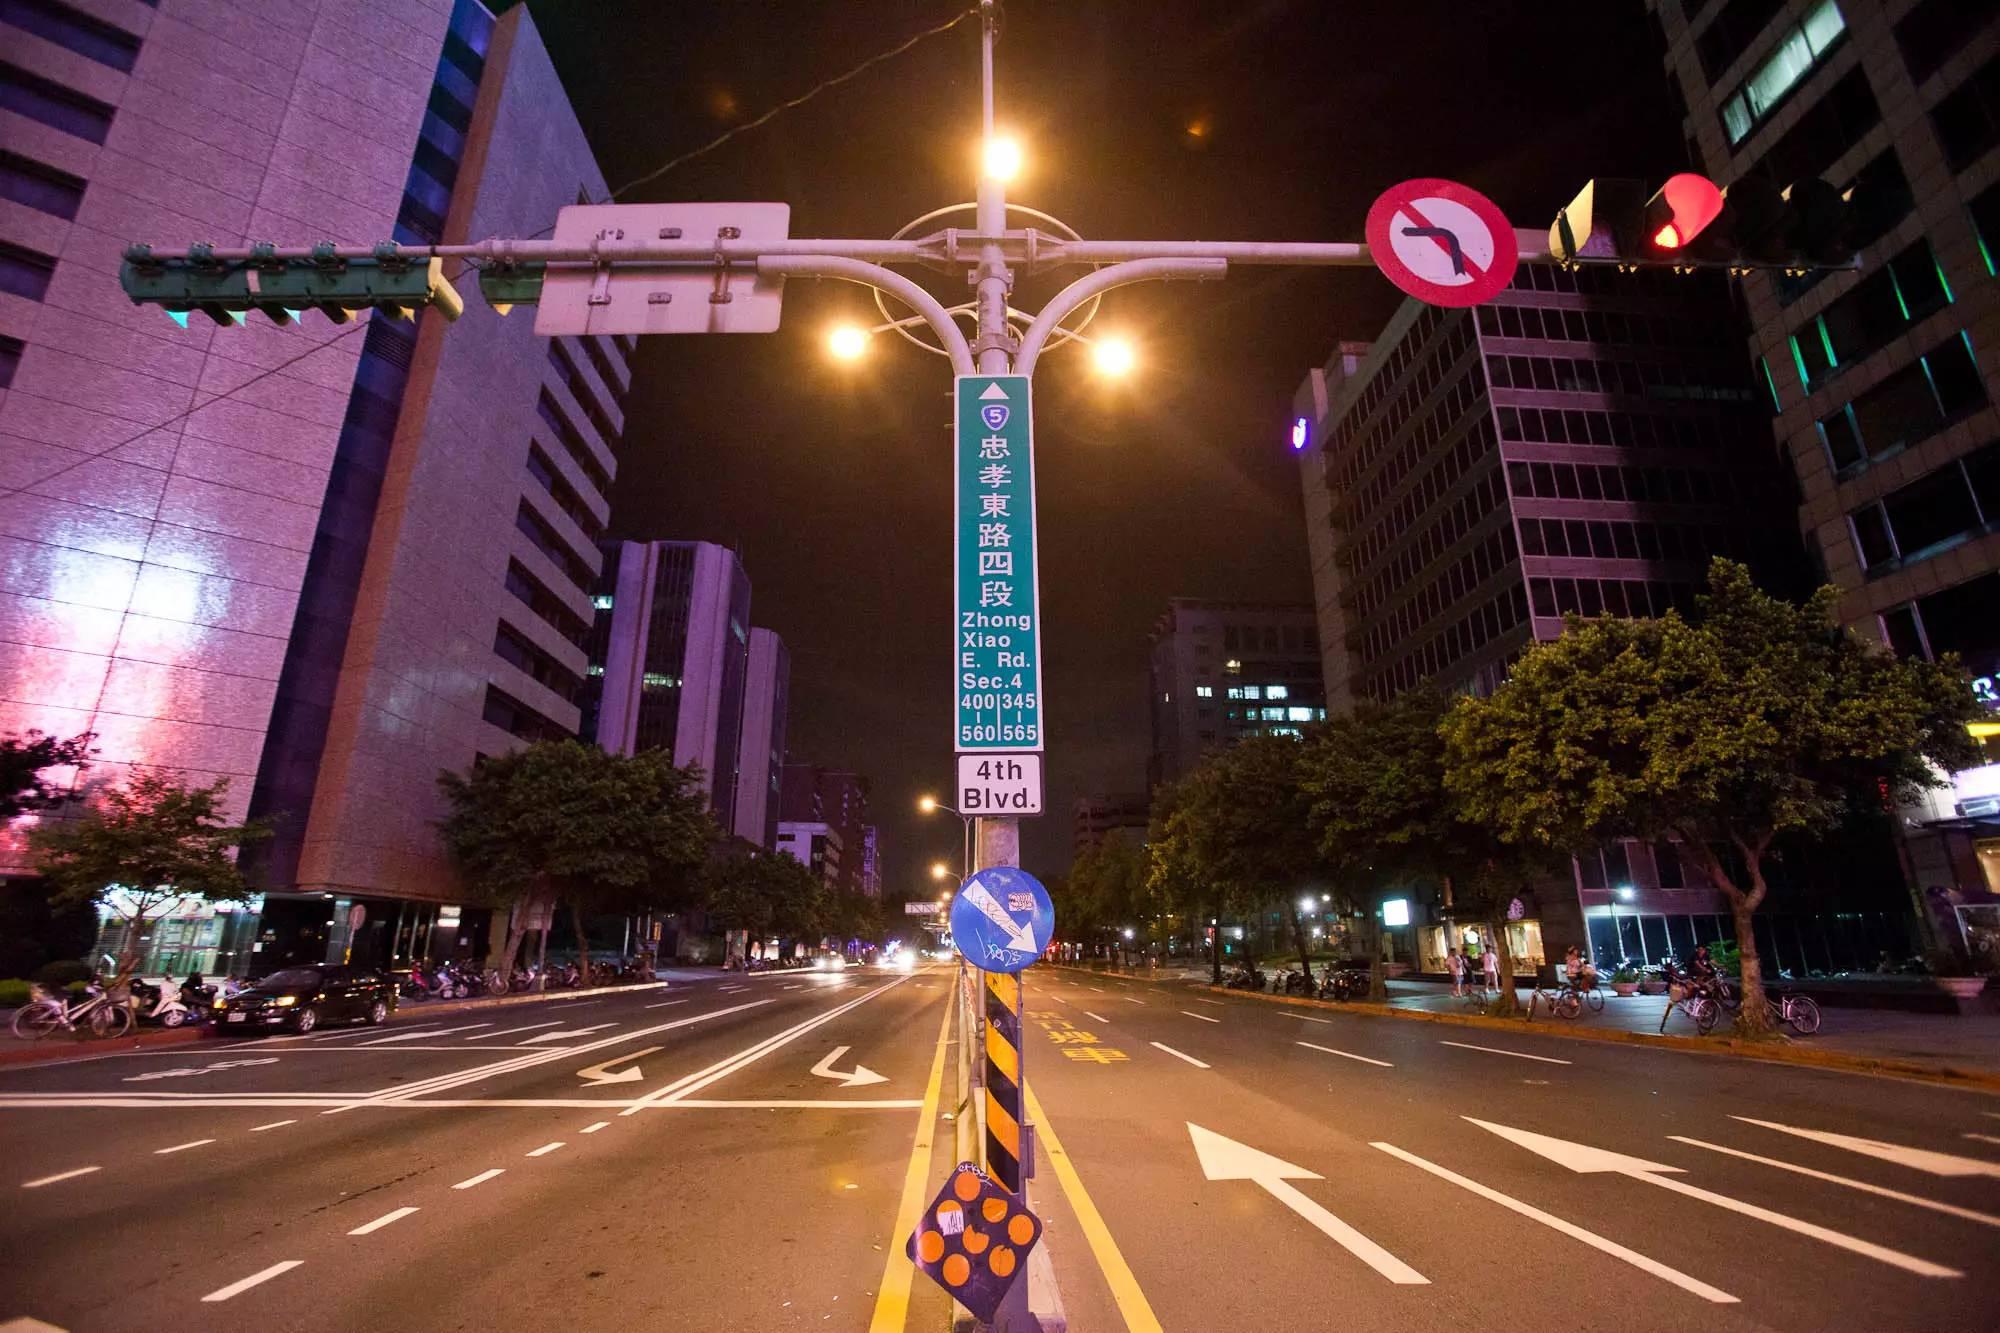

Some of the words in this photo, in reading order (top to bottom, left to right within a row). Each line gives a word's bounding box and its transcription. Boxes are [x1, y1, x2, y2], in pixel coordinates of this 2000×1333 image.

[988, 408, 1002, 423] 5
[978, 434, 1013, 607] 忠孝東路四段
[962, 612, 1031, 631] Zhong
[962, 632, 1011, 648] Xiao
[962, 652, 981, 668] E.
[997, 652, 1031, 668] Rd.
[962, 673, 1023, 689] Sec.4
[961, 694, 995, 710] 400
[1002, 693, 1036, 709] 345
[962, 726, 995, 742] 560
[1003, 725, 1037, 741] 565
[976, 760, 1023, 780] 4th
[963, 788, 1036, 809] Blvd.
